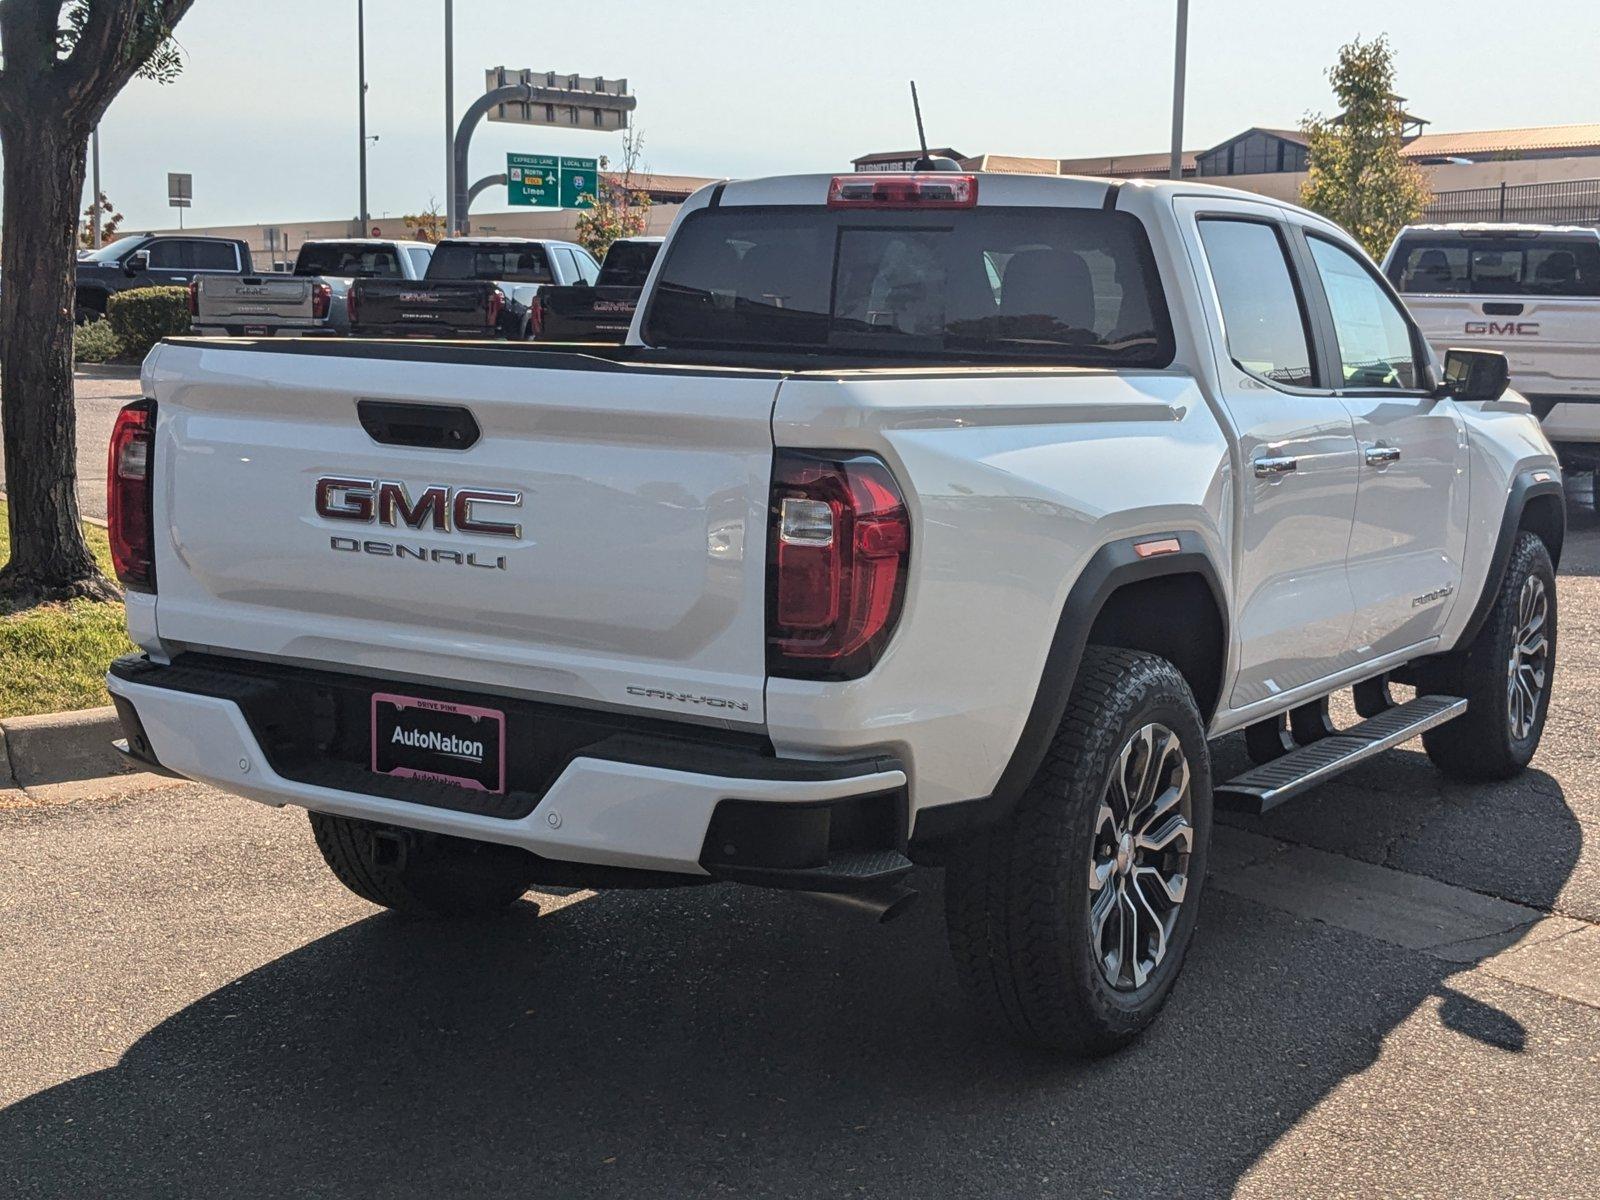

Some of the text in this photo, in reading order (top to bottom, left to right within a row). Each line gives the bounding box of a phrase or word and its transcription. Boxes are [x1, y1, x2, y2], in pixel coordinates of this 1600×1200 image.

[858, 161, 904, 172] FURNITURE
[522, 187, 545, 196] Limon
[1464, 322, 1540, 336] GMC
[315, 474, 523, 540] GMC
[330, 536, 507, 571] DENALI
[417, 701, 457, 713] DRIVE PINK
[626, 686, 748, 711] CANYON
[391, 726, 483, 757] AutoNation
